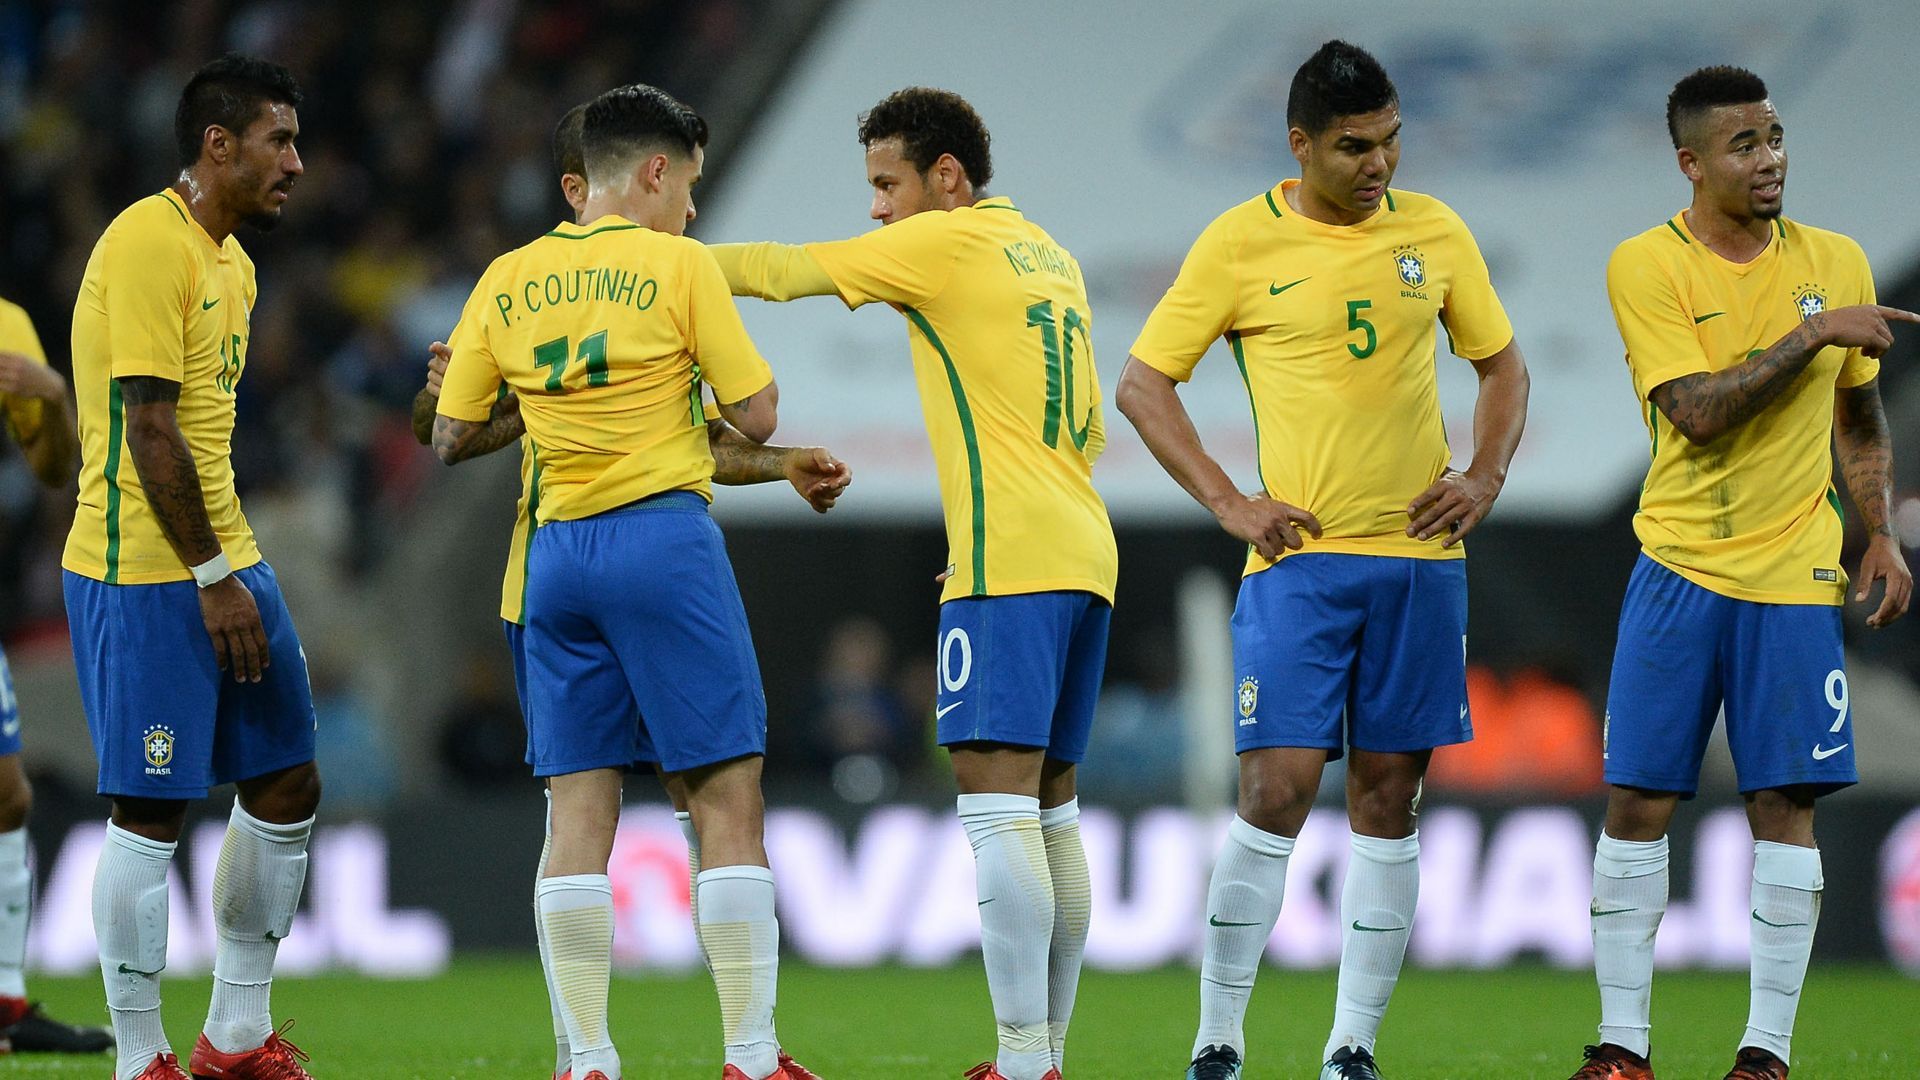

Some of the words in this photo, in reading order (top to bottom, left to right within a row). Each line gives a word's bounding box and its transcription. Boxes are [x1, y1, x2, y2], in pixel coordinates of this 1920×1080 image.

[524, 267, 657, 311] COUTINHO
[1400, 290, 1429, 300] BRASIL
[1346, 299, 1378, 360] 5
[215, 334, 241, 394] 15
[1026, 299, 1093, 452] 10
[936, 627, 972, 692] 10
[1824, 669, 1849, 732] 9
[145, 767, 172, 775] BRASIL
